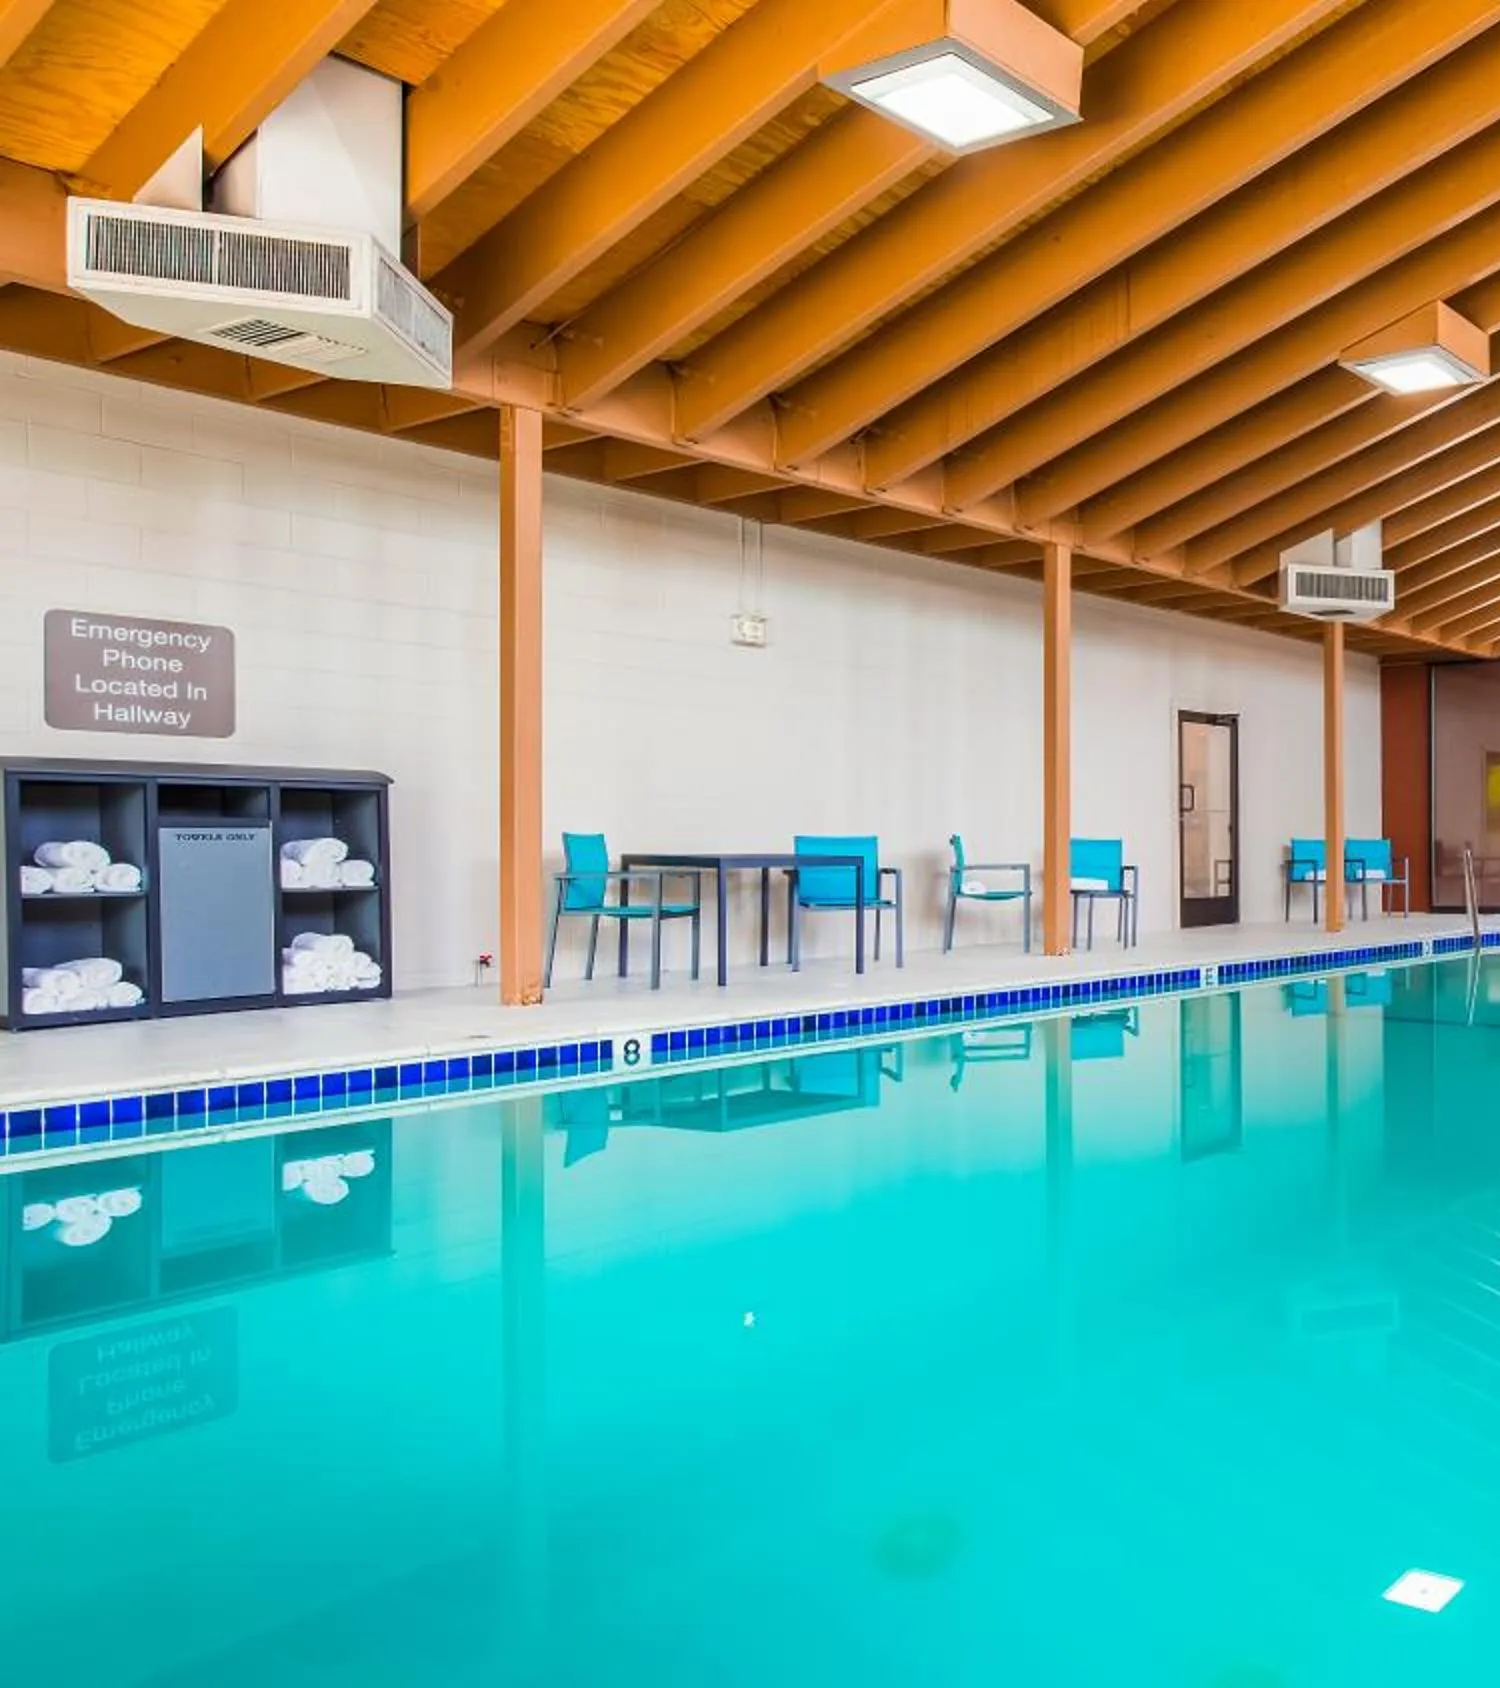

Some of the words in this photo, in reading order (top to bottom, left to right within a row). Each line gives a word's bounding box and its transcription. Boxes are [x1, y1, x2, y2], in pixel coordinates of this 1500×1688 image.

[71, 617, 212, 652] Emergency
[102, 648, 184, 673] Phone
[75, 673, 178, 699] Located
[187, 681, 208, 701] In
[94, 702, 191, 729] Hallway
[623, 1038, 641, 1066] 8
